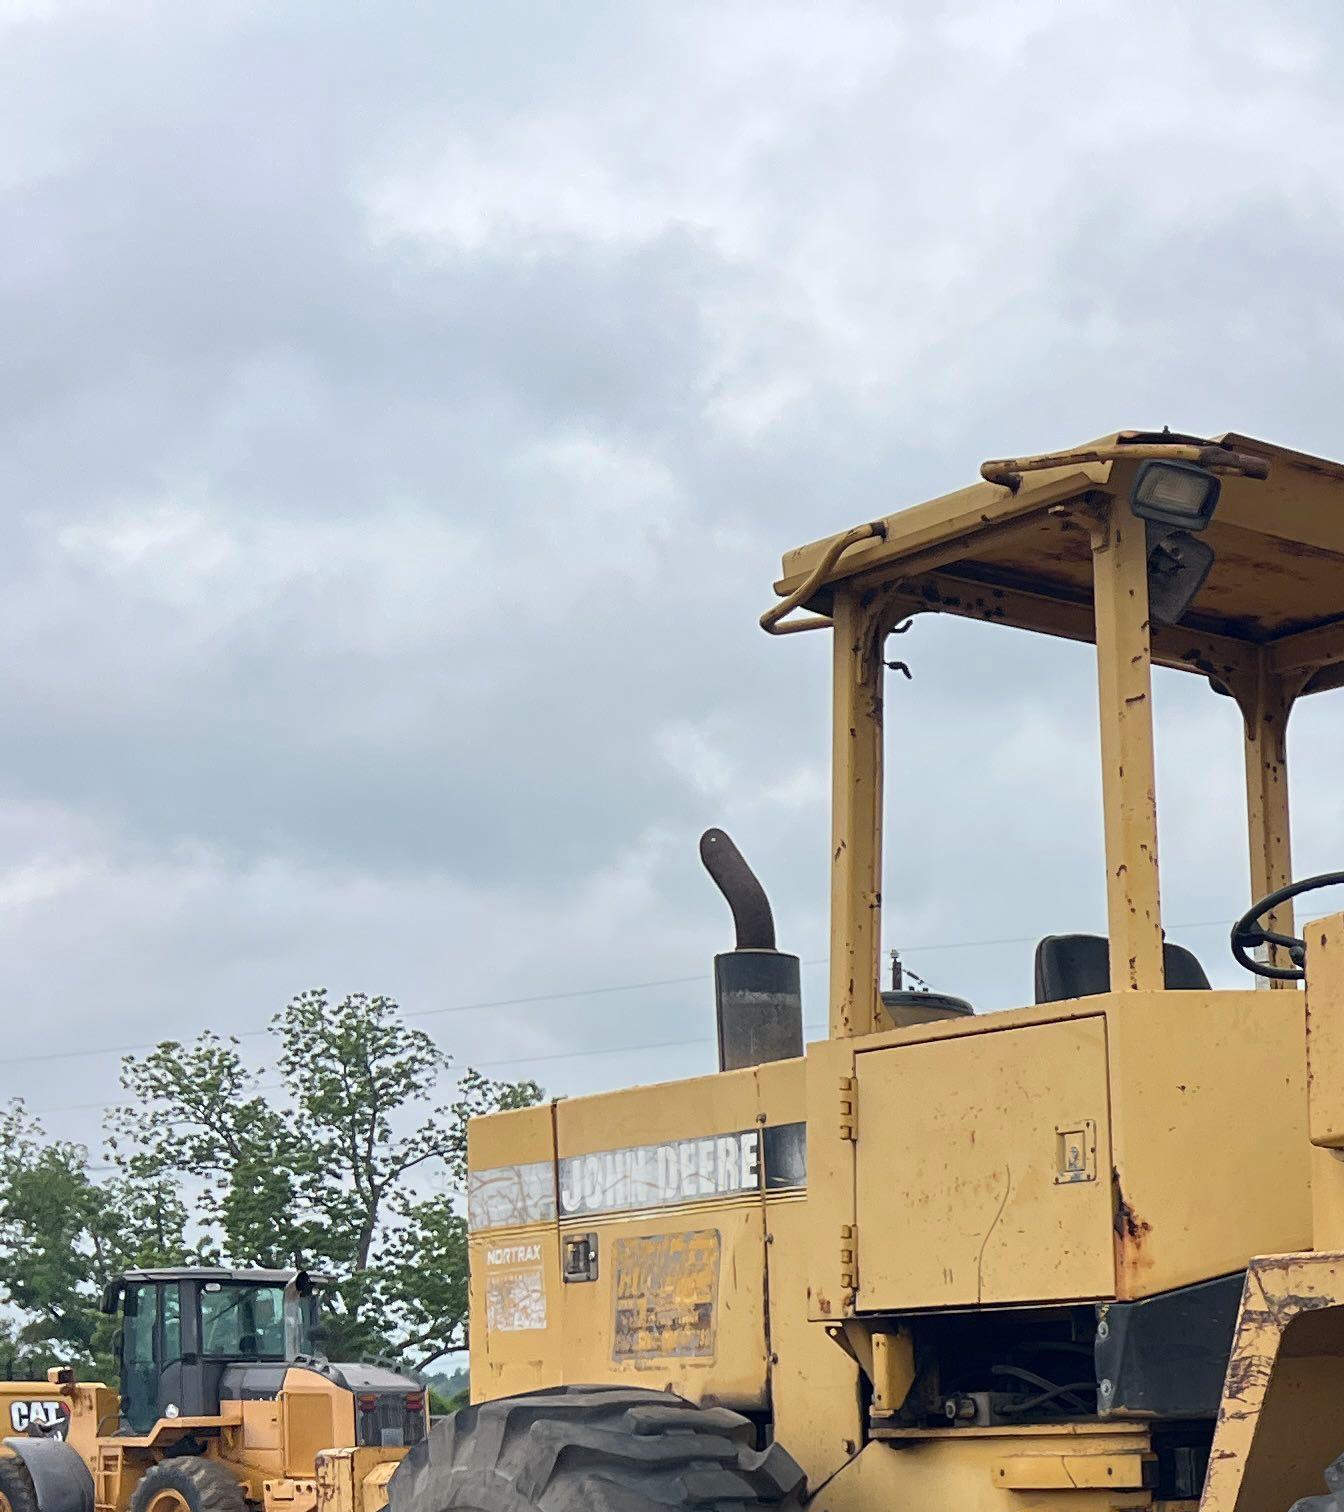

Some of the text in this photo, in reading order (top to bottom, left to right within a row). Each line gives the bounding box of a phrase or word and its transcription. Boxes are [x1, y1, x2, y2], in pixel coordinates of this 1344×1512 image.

[656, 1132, 759, 1201] DEERE
[486, 1244, 542, 1266] NORTRAX
[10, 1401, 60, 1432] CAT
